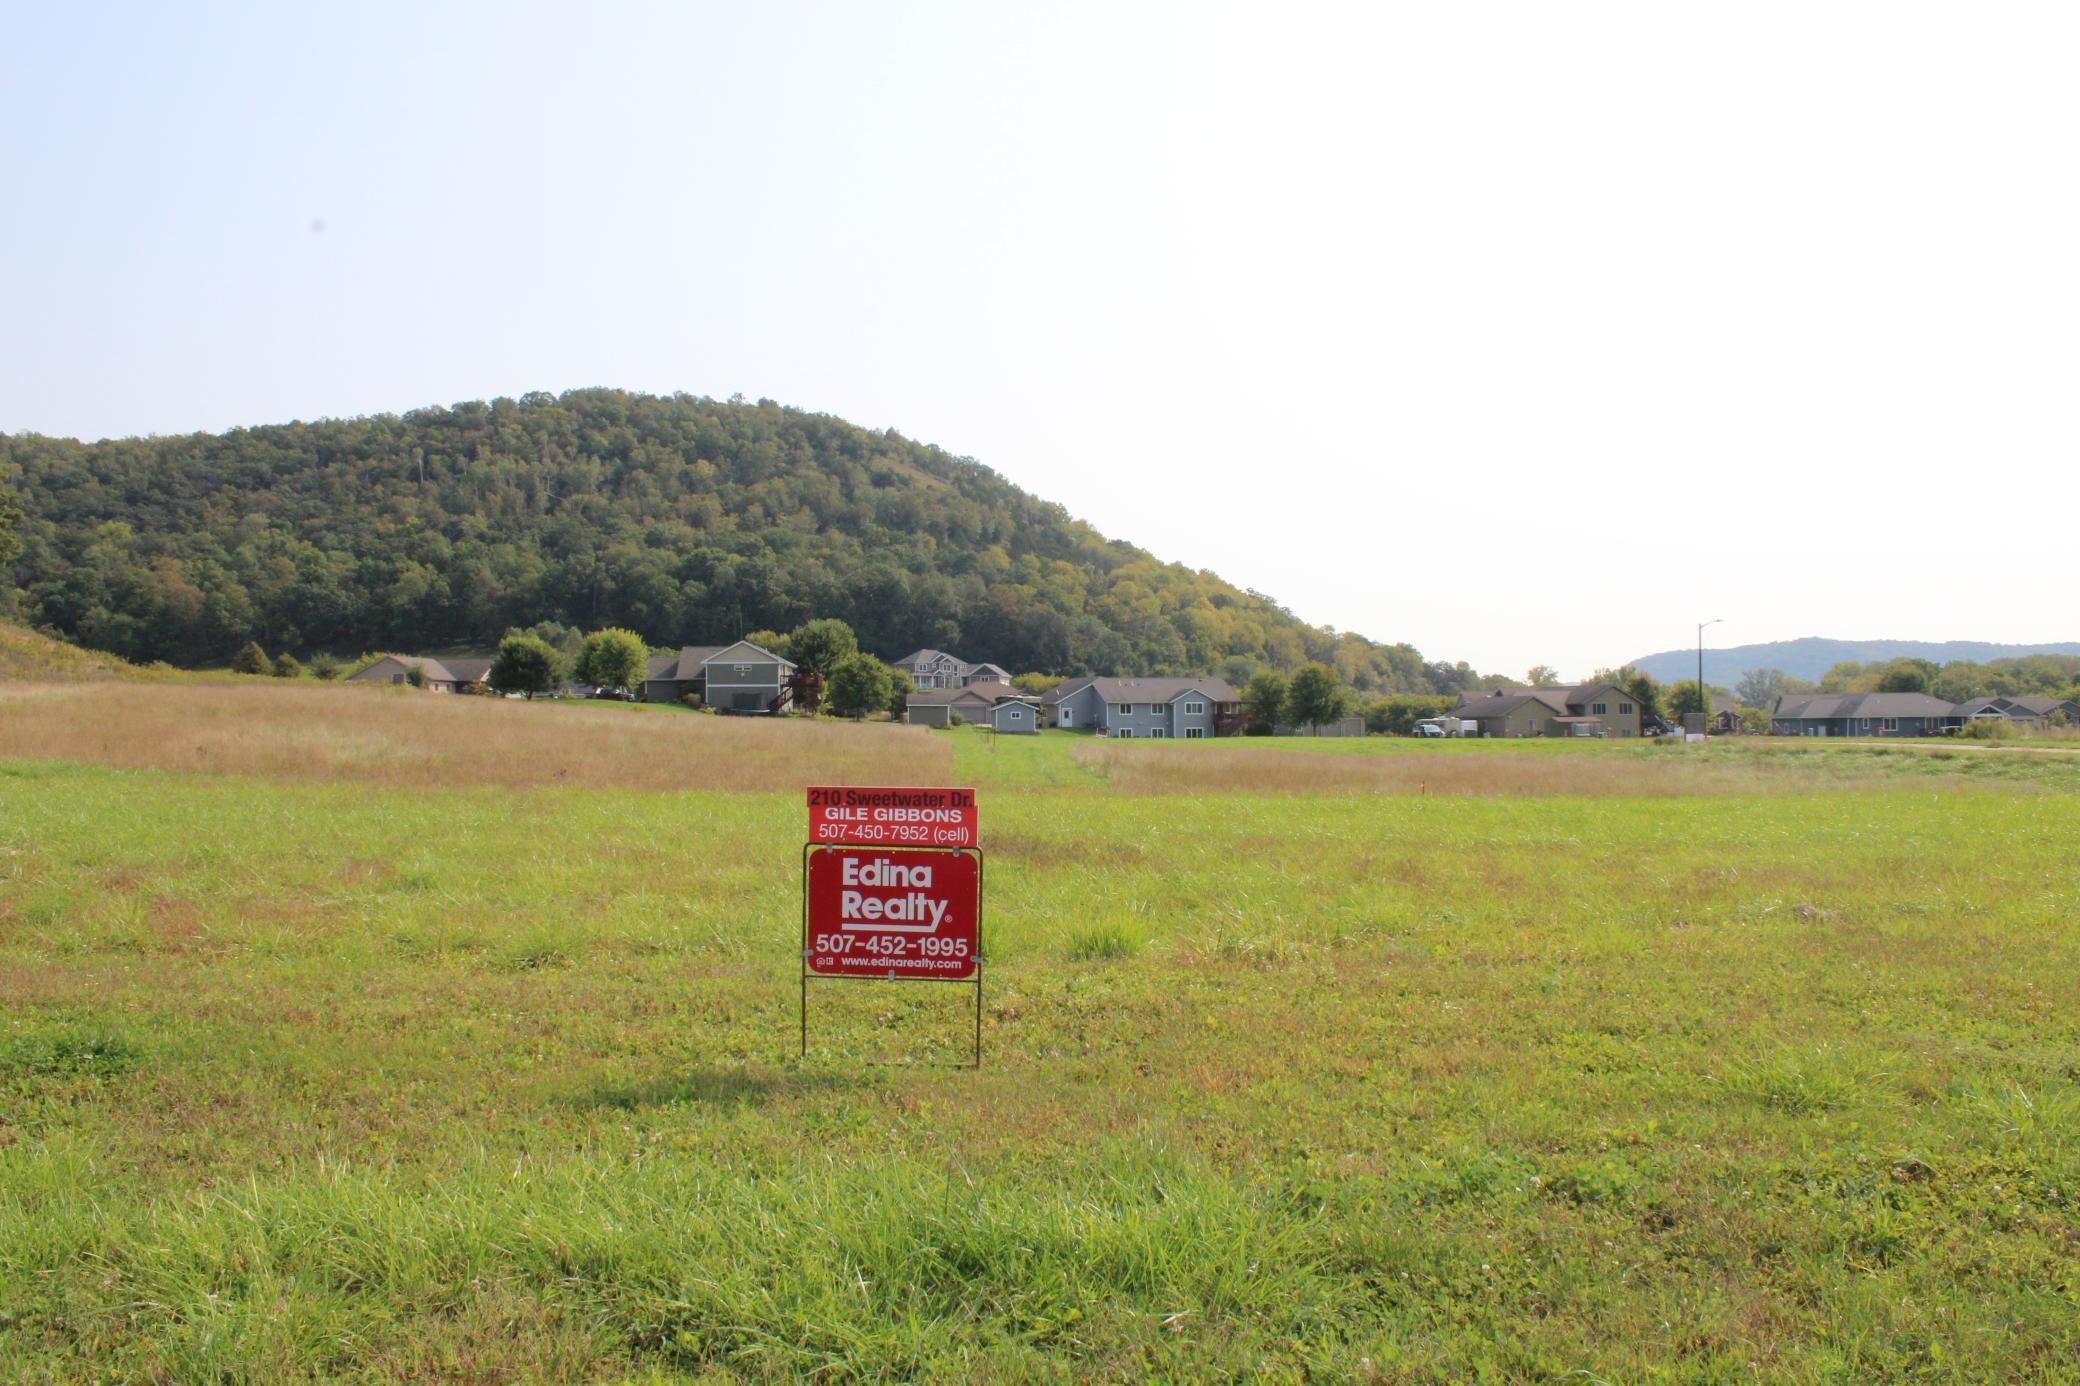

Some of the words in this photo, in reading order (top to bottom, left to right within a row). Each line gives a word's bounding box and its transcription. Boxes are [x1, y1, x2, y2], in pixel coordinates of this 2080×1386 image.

[811, 790, 842, 806] 210
[846, 791, 946, 807] Sweetwater
[951, 793, 973, 808] Dr.
[825, 808, 868, 821] GILE
[874, 809, 962, 823] GIBBONS
[819, 824, 928, 841] 507-450-7952
[934, 826, 969, 843] (cell)
[842, 857, 932, 888] Edina
[842, 891, 948, 932] Realty
[816, 934, 968, 957] 507-452-1995
[842, 957, 962, 970] www.edinarealty.com
